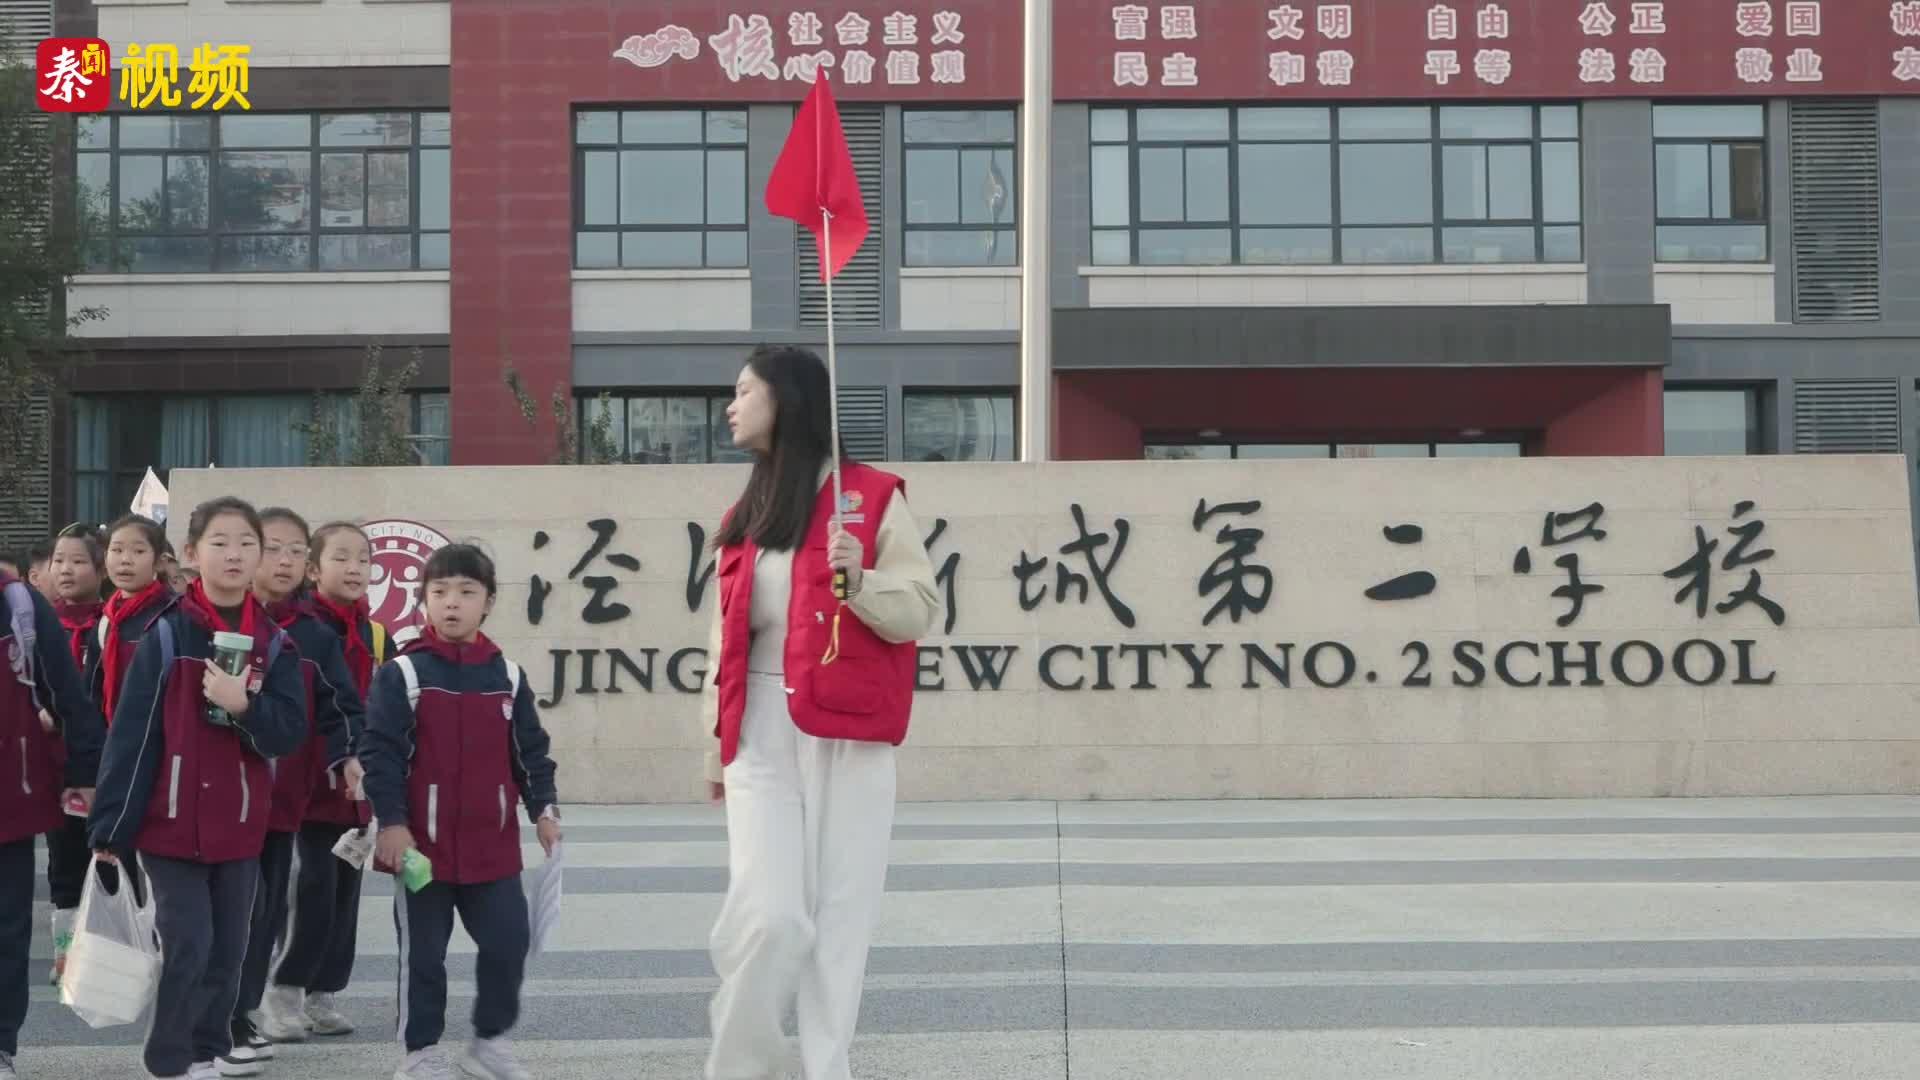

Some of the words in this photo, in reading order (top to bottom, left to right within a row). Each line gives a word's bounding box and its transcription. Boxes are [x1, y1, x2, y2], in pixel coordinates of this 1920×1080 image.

[788, 11, 965, 46] 社会主义
[1112, 4, 1198, 41] 富强
[1267, 4, 1353, 40] 文明
[1427, 4, 1509, 40] 自由
[1578, 2, 1666, 37] 公正
[1736, 1, 1821, 37] 爱国
[1112, 51, 1199, 87] 民主
[1268, 50, 1354, 86] 和谐
[1424, 49, 1512, 85] 平等
[1578, 48, 1667, 83] 法治
[1735, 47, 1823, 83] 敬业
[370, 524, 406, 538] CITY
[537, 647, 711, 710] JING
[914, 644, 1019, 692] EW
[1038, 643, 1224, 692] CITY
[1240, 640, 1378, 690] NO.
[1401, 640, 1432, 688] 2
[1452, 638, 1777, 689] SCHOOL
